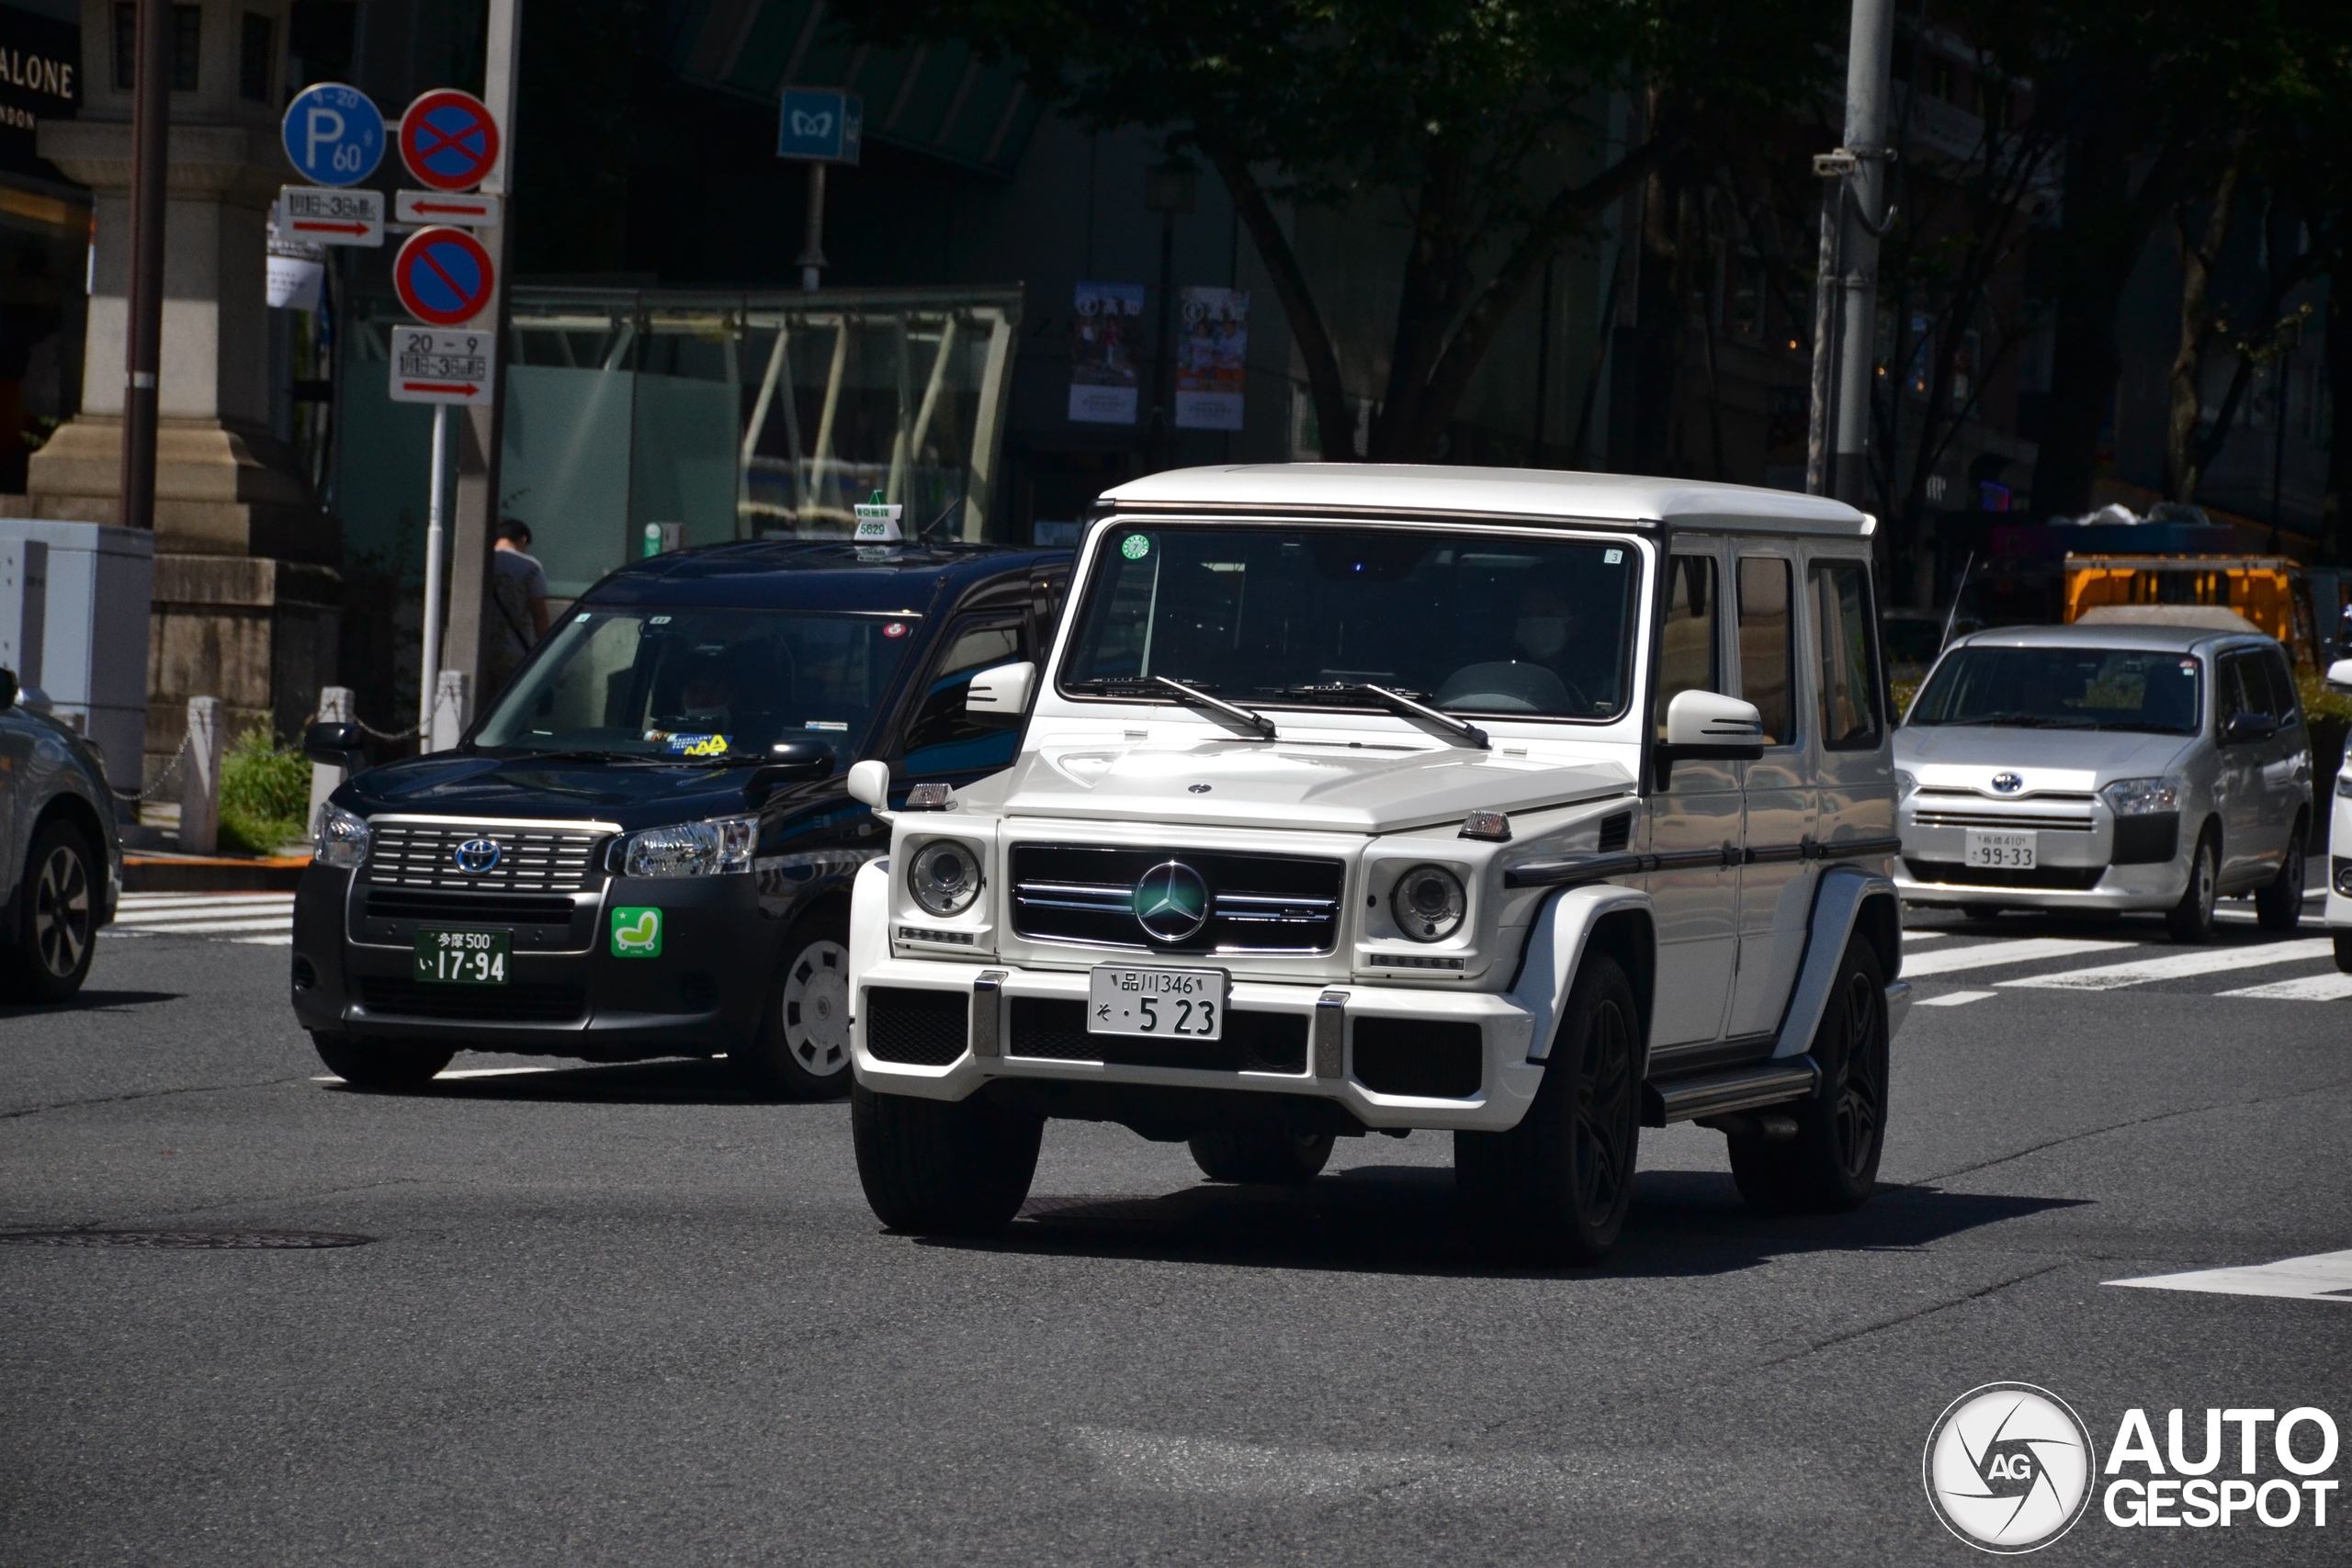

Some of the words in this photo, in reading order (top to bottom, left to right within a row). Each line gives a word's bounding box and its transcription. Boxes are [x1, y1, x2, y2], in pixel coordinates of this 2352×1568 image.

[306, 107, 345, 169] P
[332, 145, 361, 172] 60
[408, 334, 433, 353] 20
[467, 337, 478, 355] 9
[860, 525, 885, 535] 5629
[1611, 553, 1618, 561] 3
[1982, 848, 2032, 865] 99-33
[438, 951, 504, 981] 17-94
